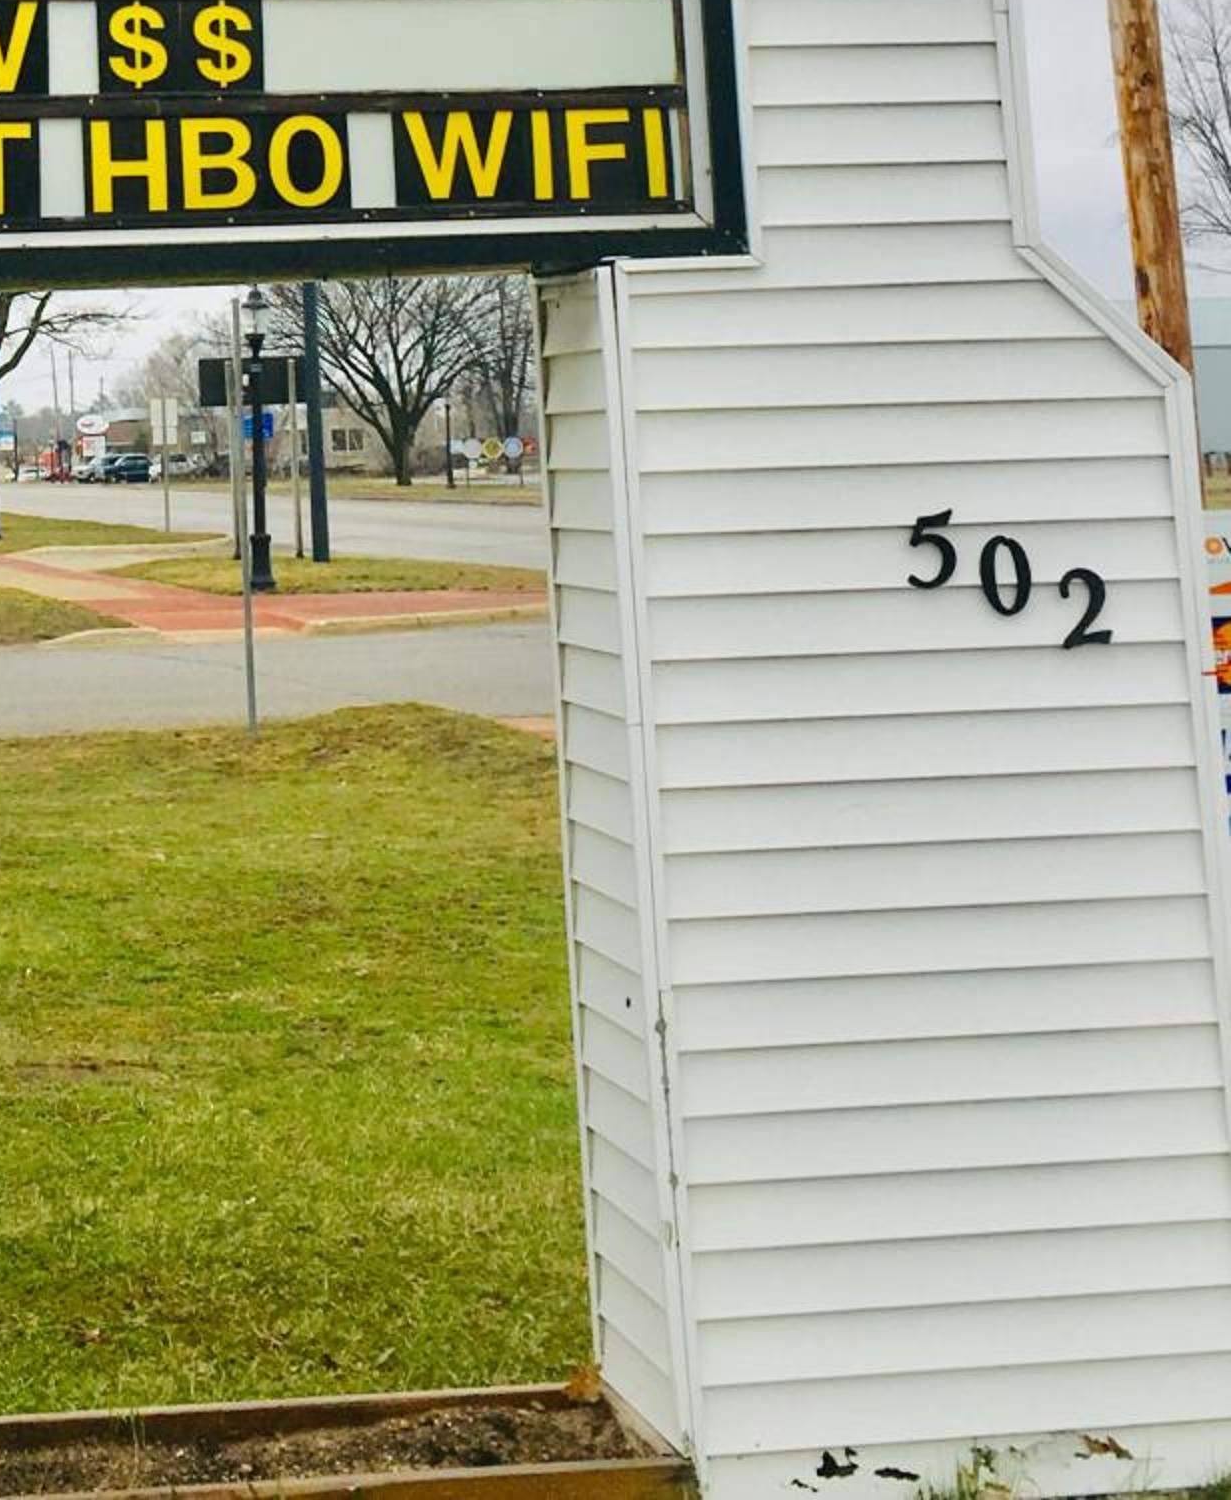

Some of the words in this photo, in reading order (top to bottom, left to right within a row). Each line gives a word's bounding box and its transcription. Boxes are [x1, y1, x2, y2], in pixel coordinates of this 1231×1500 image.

[109, 2, 252, 87] $$
[90, 115, 343, 213] HBO
[403, 108, 668, 200] WIFI
[907, 508, 1113, 649] 502
